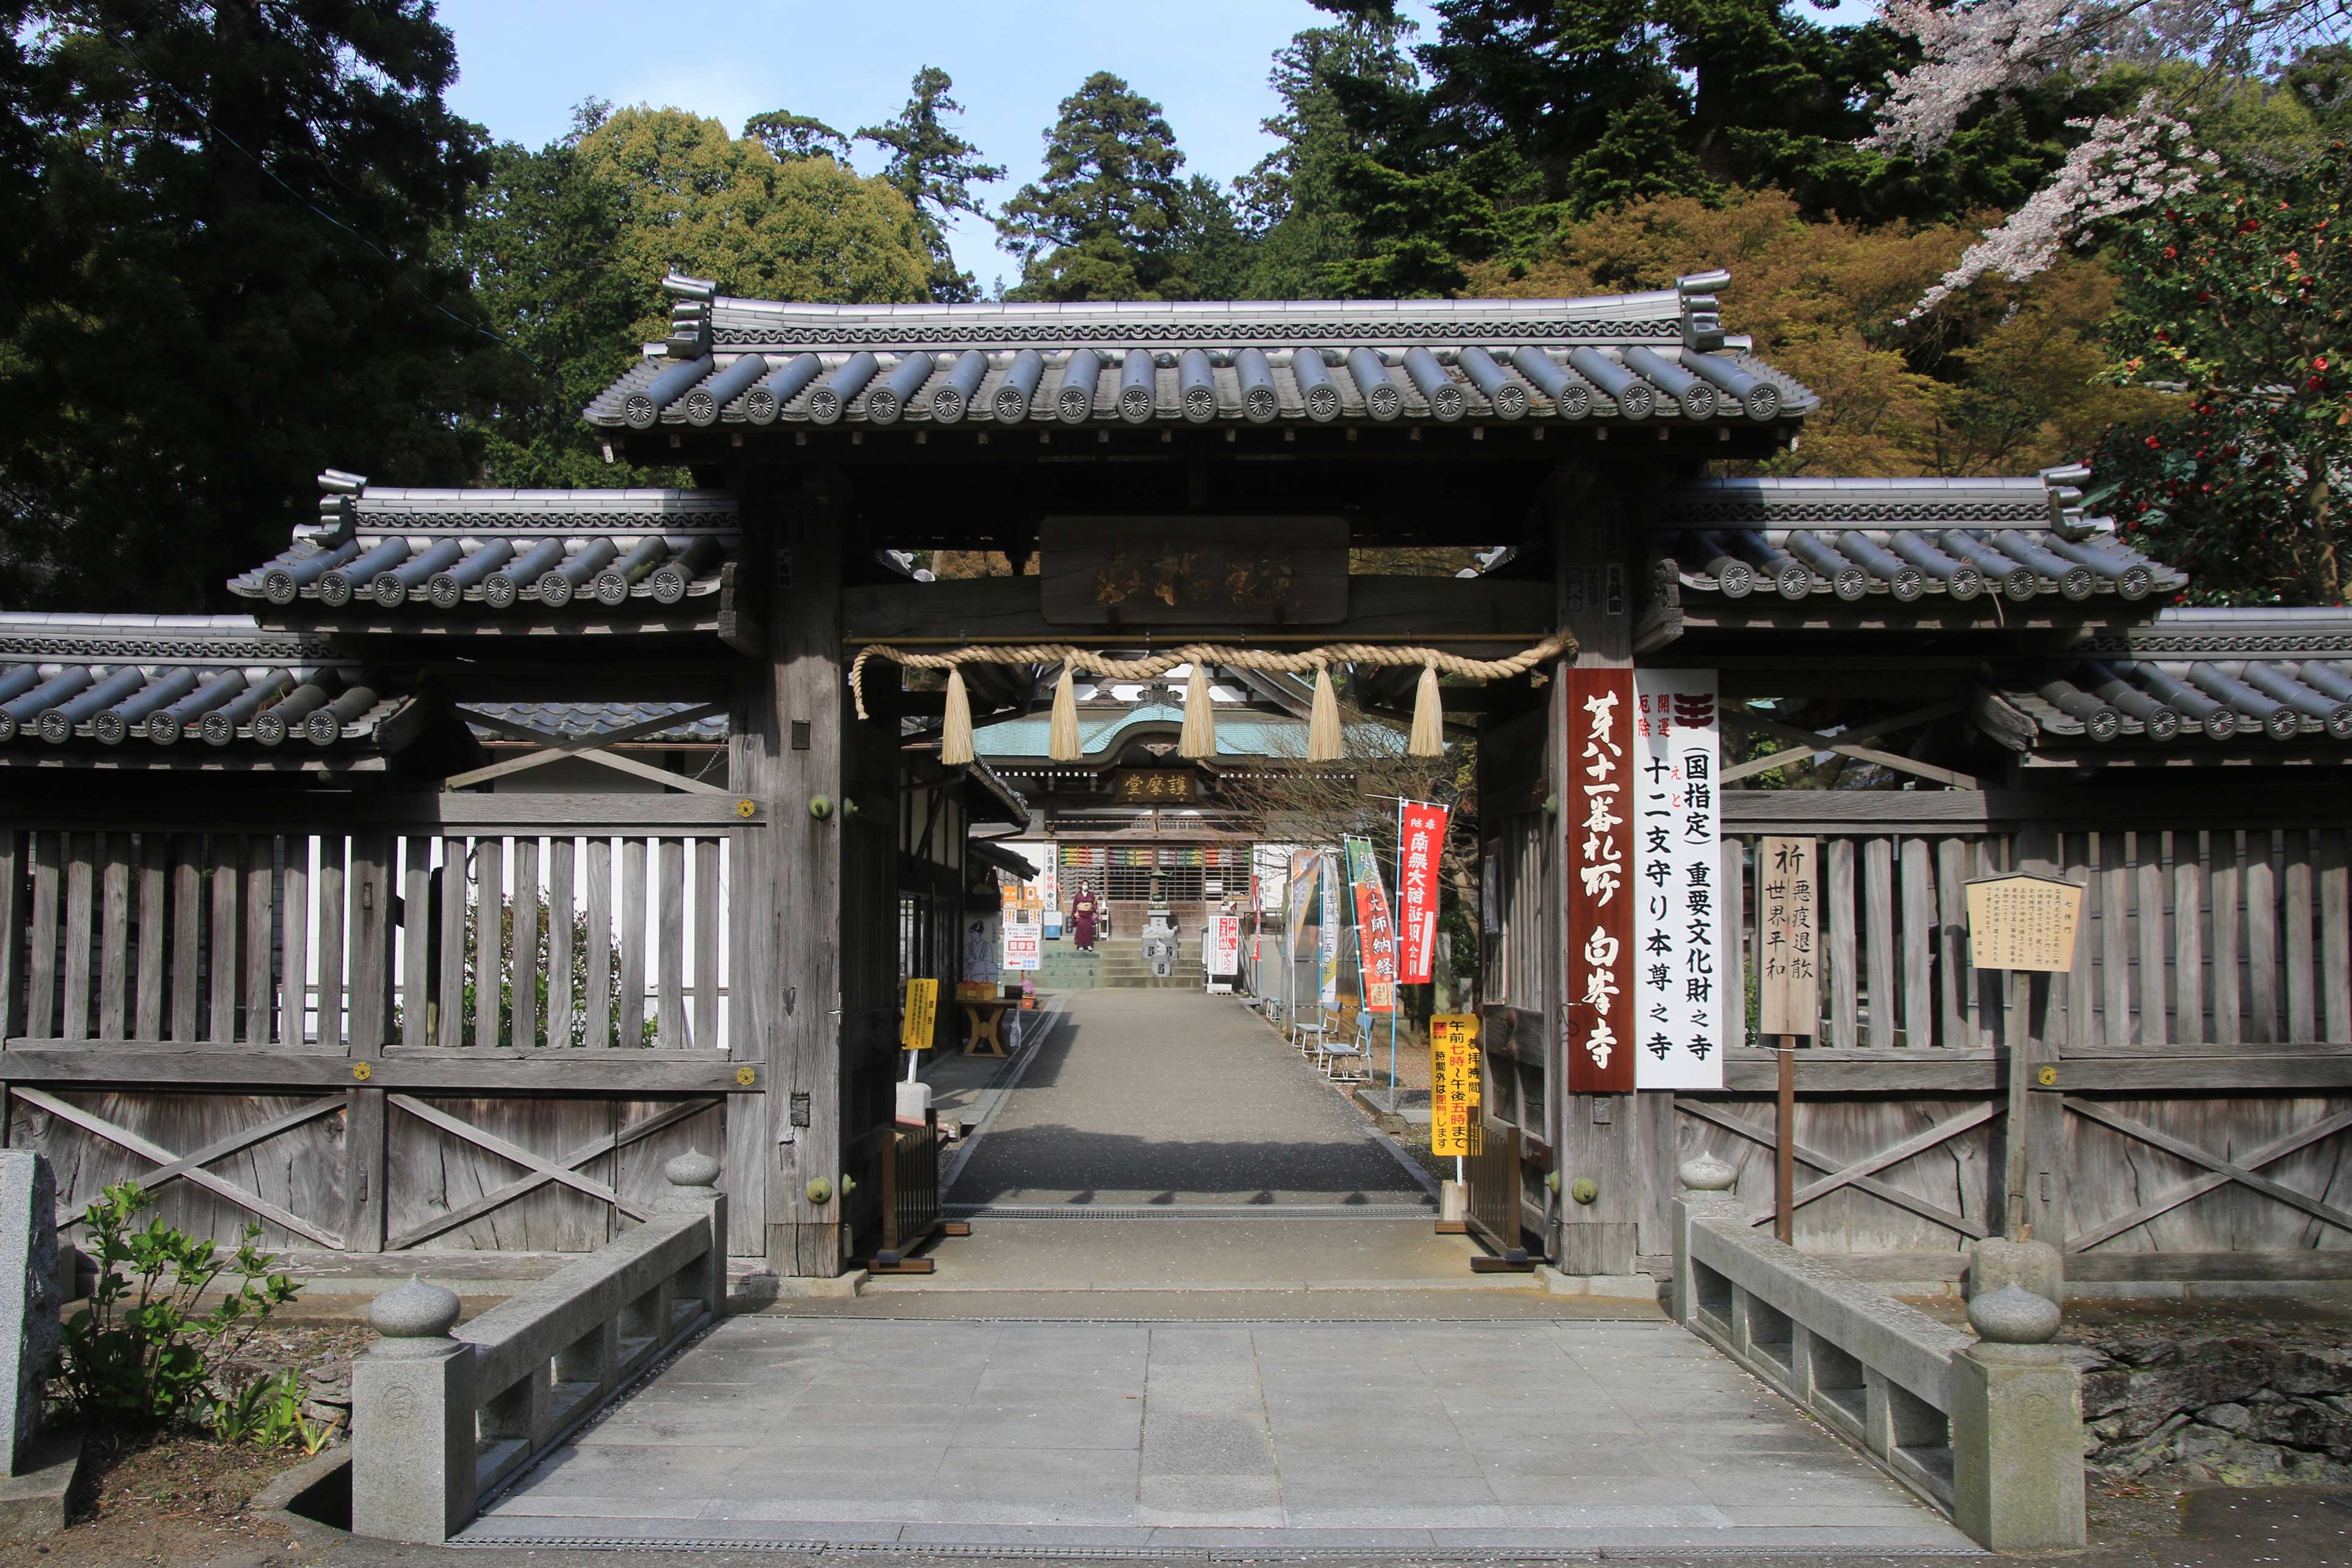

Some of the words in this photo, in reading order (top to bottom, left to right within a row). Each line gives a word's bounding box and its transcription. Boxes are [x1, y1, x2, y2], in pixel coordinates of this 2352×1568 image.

[1638, 693, 1651, 738] 厄除
[1657, 694, 1671, 739] 開運
[1670, 765, 1681, 809] えと
[1644, 756, 1673, 1061] 十二支守り本尊之寺
[1774, 844, 1805, 875] 祈
[1684, 861, 1714, 1062] 重要文化財之寺
[1765, 880, 1786, 980] 世界平和
[1790, 880, 1813, 979] 悪疫退散
[1435, 1051, 1447, 1149] 時間外は閉門します
